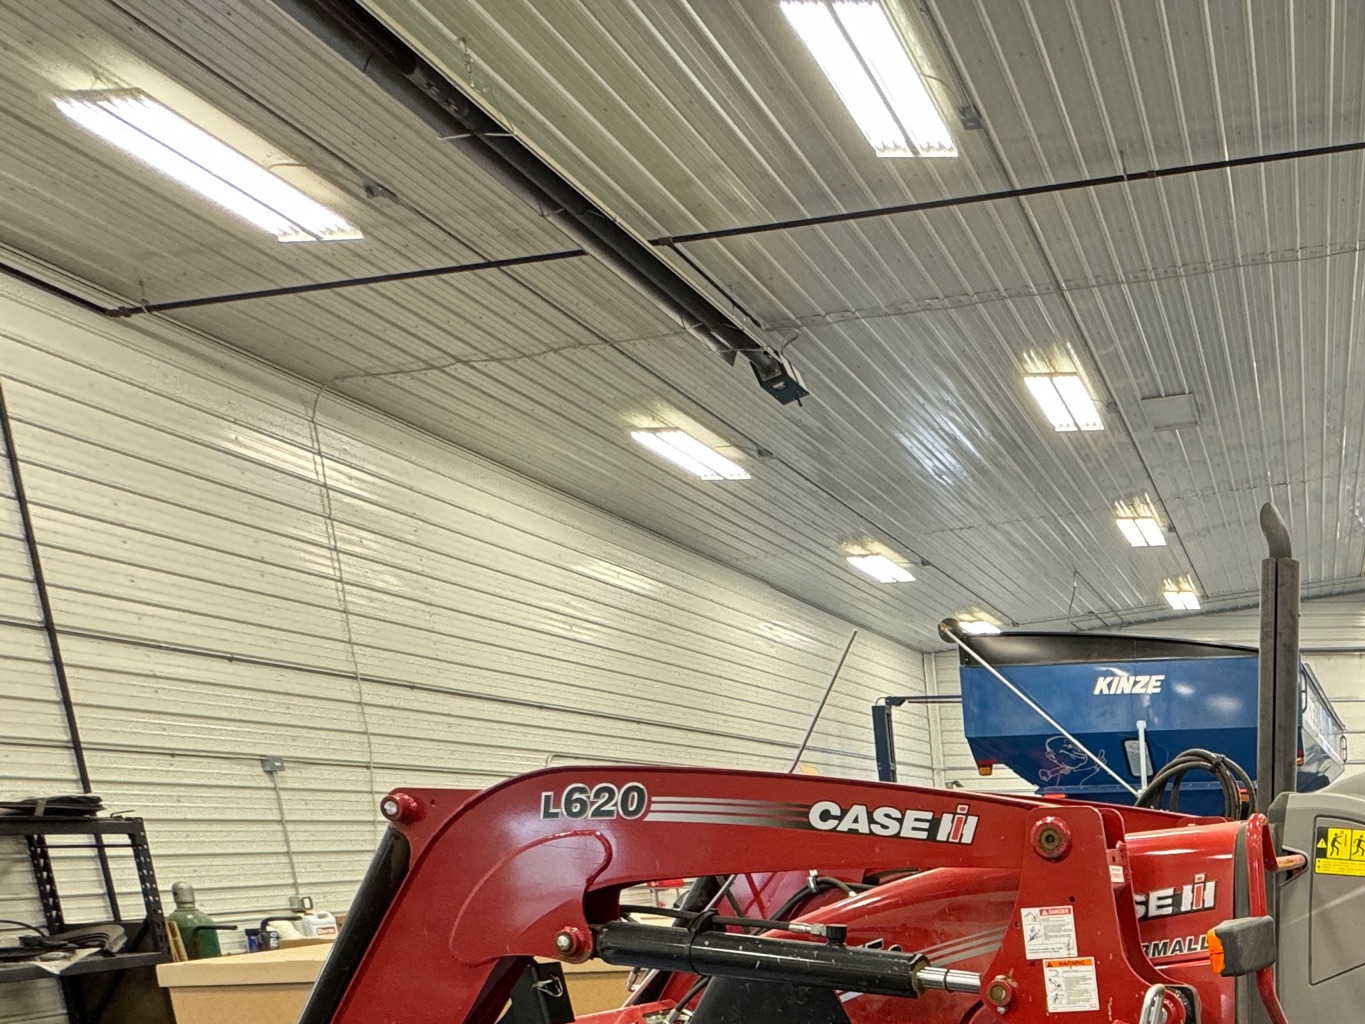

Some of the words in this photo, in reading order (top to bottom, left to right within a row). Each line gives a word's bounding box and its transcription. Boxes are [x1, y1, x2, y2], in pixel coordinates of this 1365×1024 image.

[1093, 674, 1166, 695] KINZE
[540, 782, 648, 820] L620
[809, 800, 934, 840] CASE
[1048, 908, 1069, 916] DANGER
